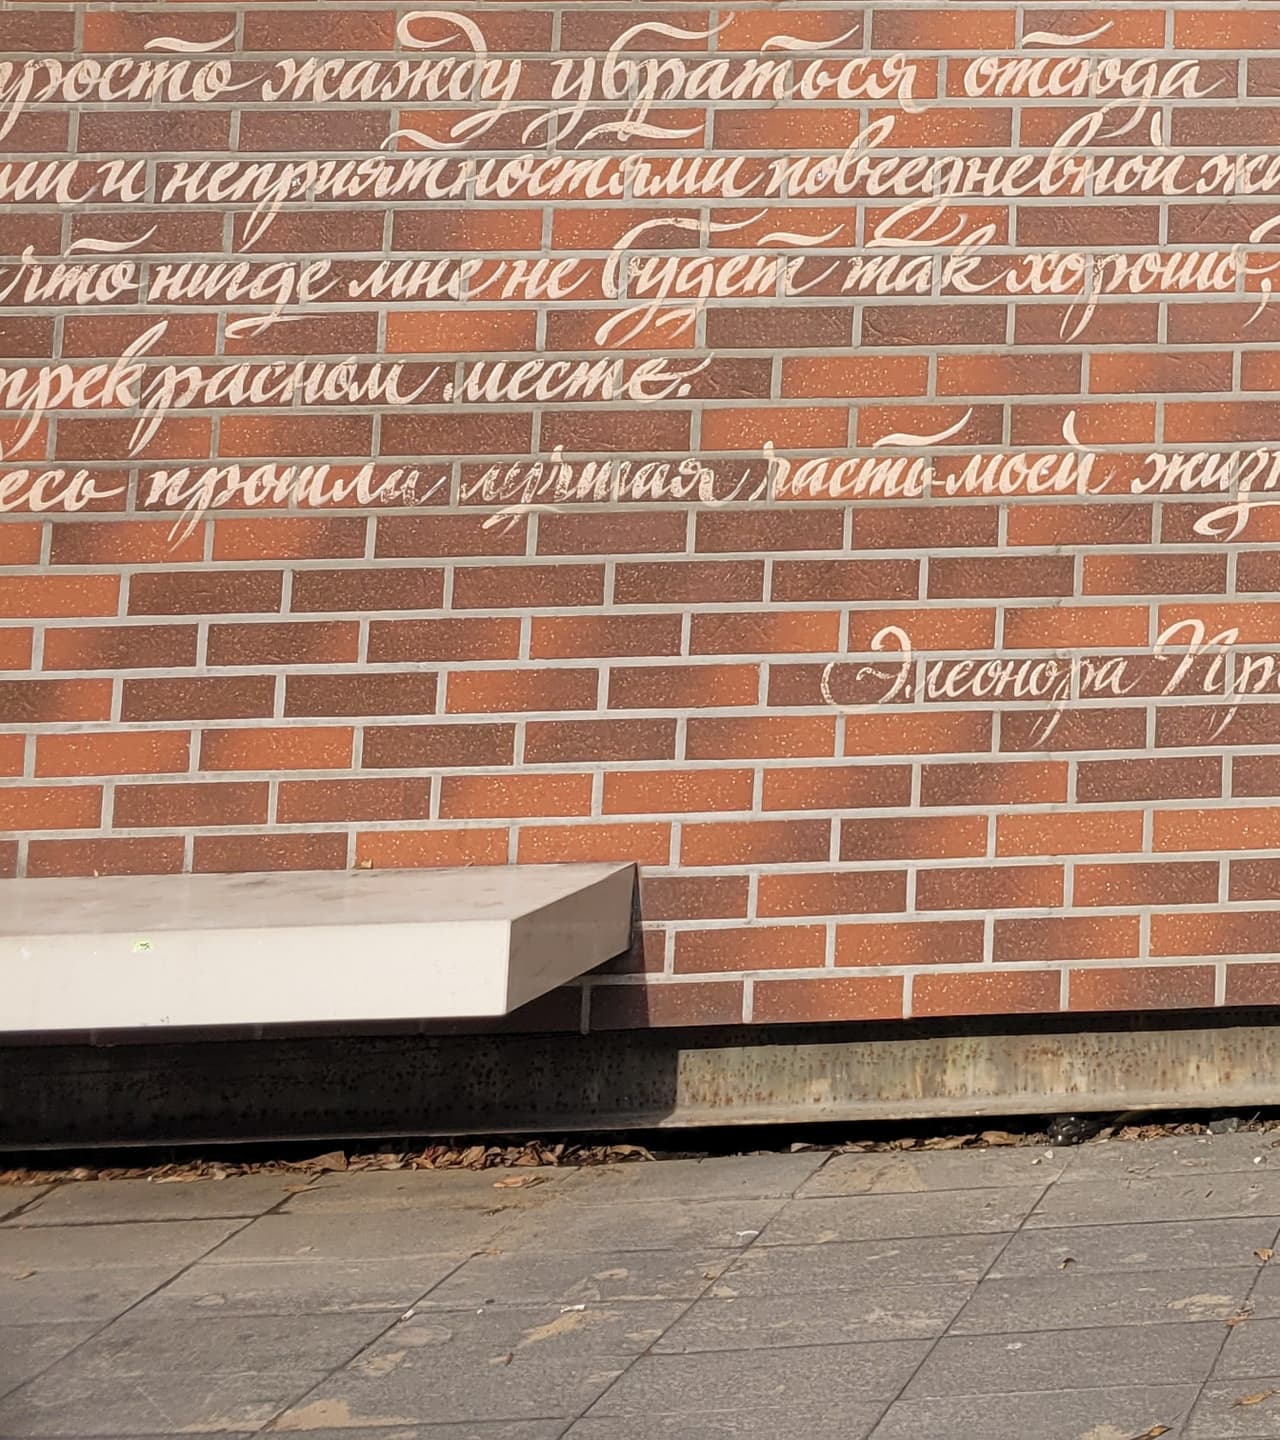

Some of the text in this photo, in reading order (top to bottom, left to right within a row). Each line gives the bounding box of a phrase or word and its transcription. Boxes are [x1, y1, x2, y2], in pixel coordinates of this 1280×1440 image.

[0, 10, 1225, 148] росто жажду убраться отсюда
[97, 159, 152, 202] и
[160, 122, 766, 253] неприятностями
[765, 112, 1193, 242] повседневной
[148, 259, 340, 339] нигде
[349, 258, 503, 301] мне
[502, 258, 592, 301] не
[595, 209, 840, 348] будет
[841, 214, 1011, 294] так
[443, 352, 714, 403] месте.
[749, 408, 973, 500] часть
[943, 410, 1115, 496] моей
[821, 626, 1143, 747] Элеонора
